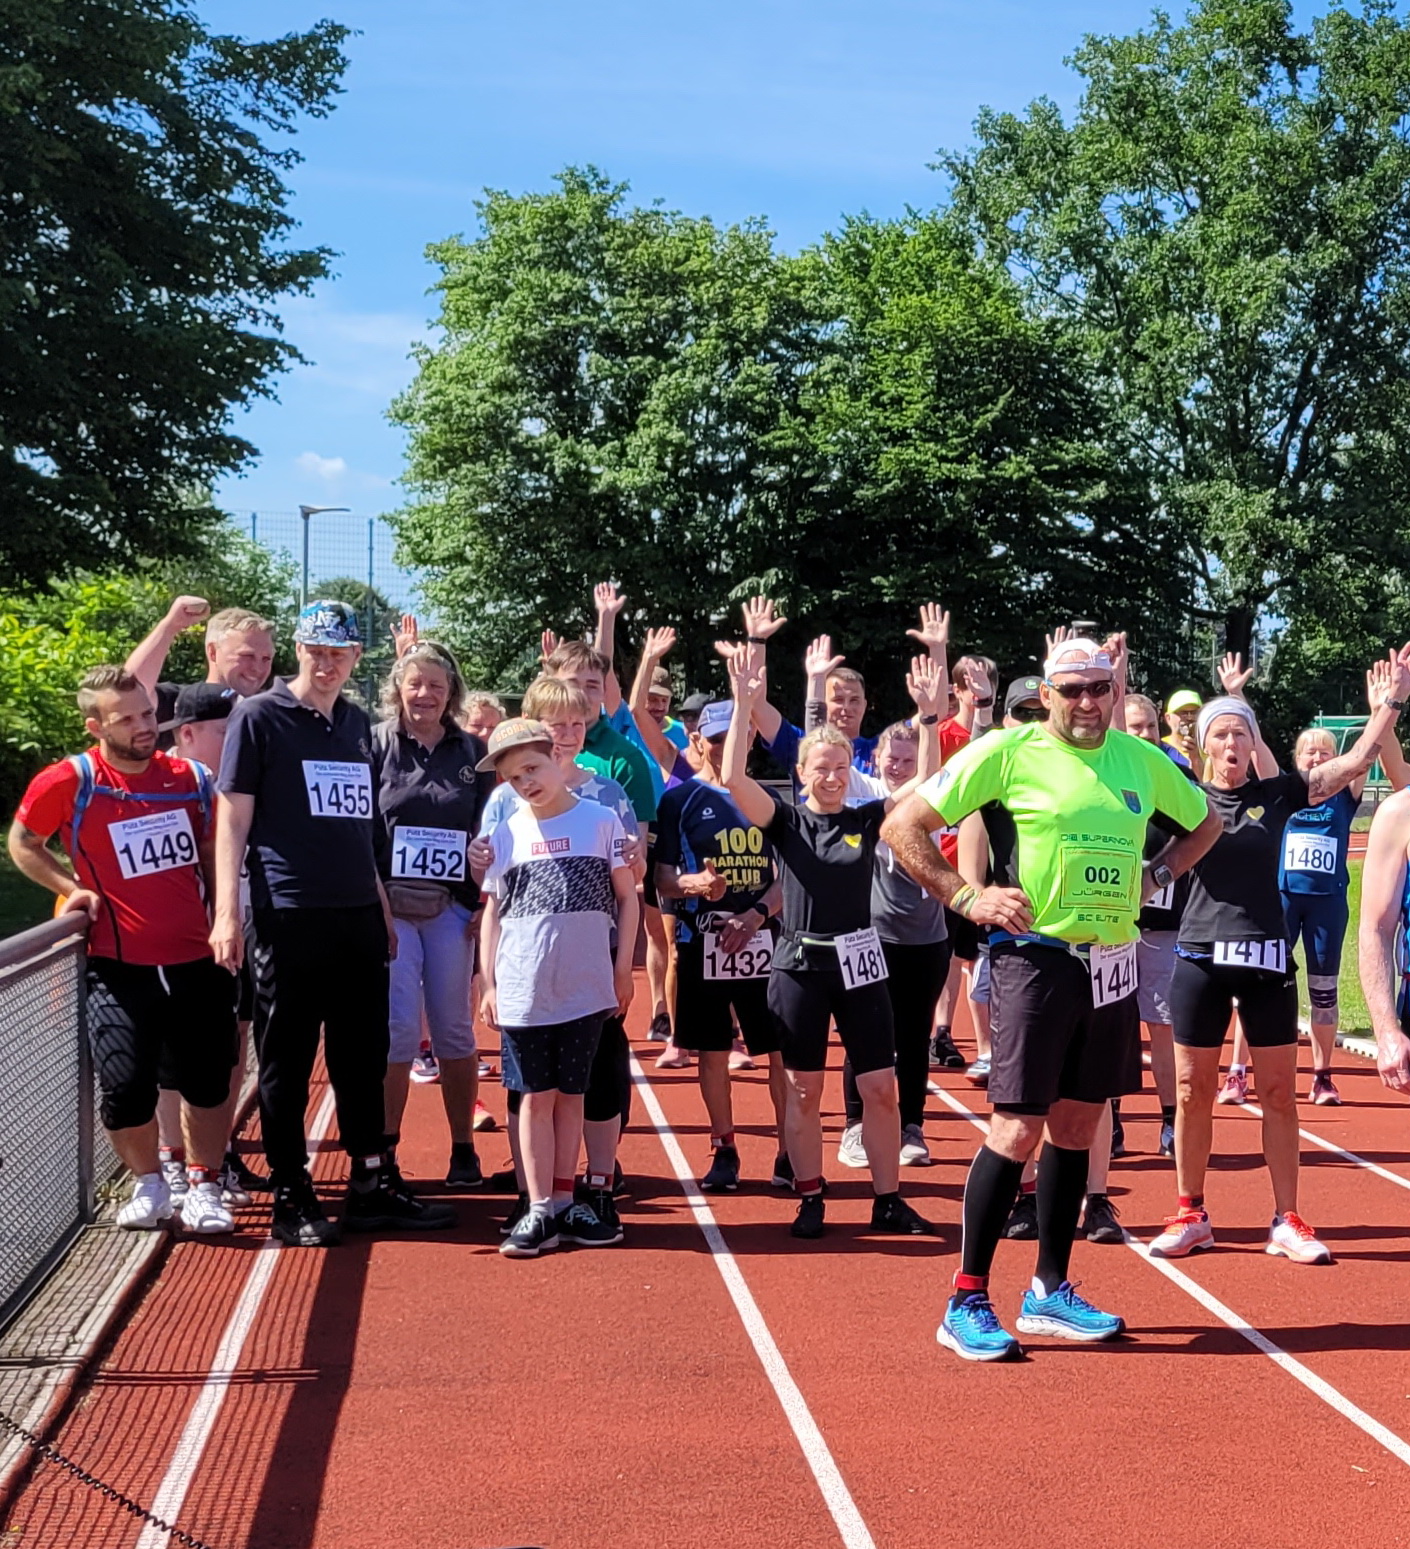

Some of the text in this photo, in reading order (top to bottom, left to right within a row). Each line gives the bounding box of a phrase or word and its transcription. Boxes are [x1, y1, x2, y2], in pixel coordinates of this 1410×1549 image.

[310, 782, 370, 816] 1455
[119, 831, 195, 874] 1449
[532, 839, 569, 854] FUTURE
[714, 826, 763, 854] 100
[395, 846, 463, 879] 1452
[710, 855, 769, 868] MARATHON
[1288, 847, 1335, 872] 1480
[722, 868, 761, 886] CLUB
[1084, 866, 1121, 886] 002
[706, 949, 772, 977] 1432
[842, 946, 887, 985] 1481
[1093, 951, 1135, 1003] 1441
